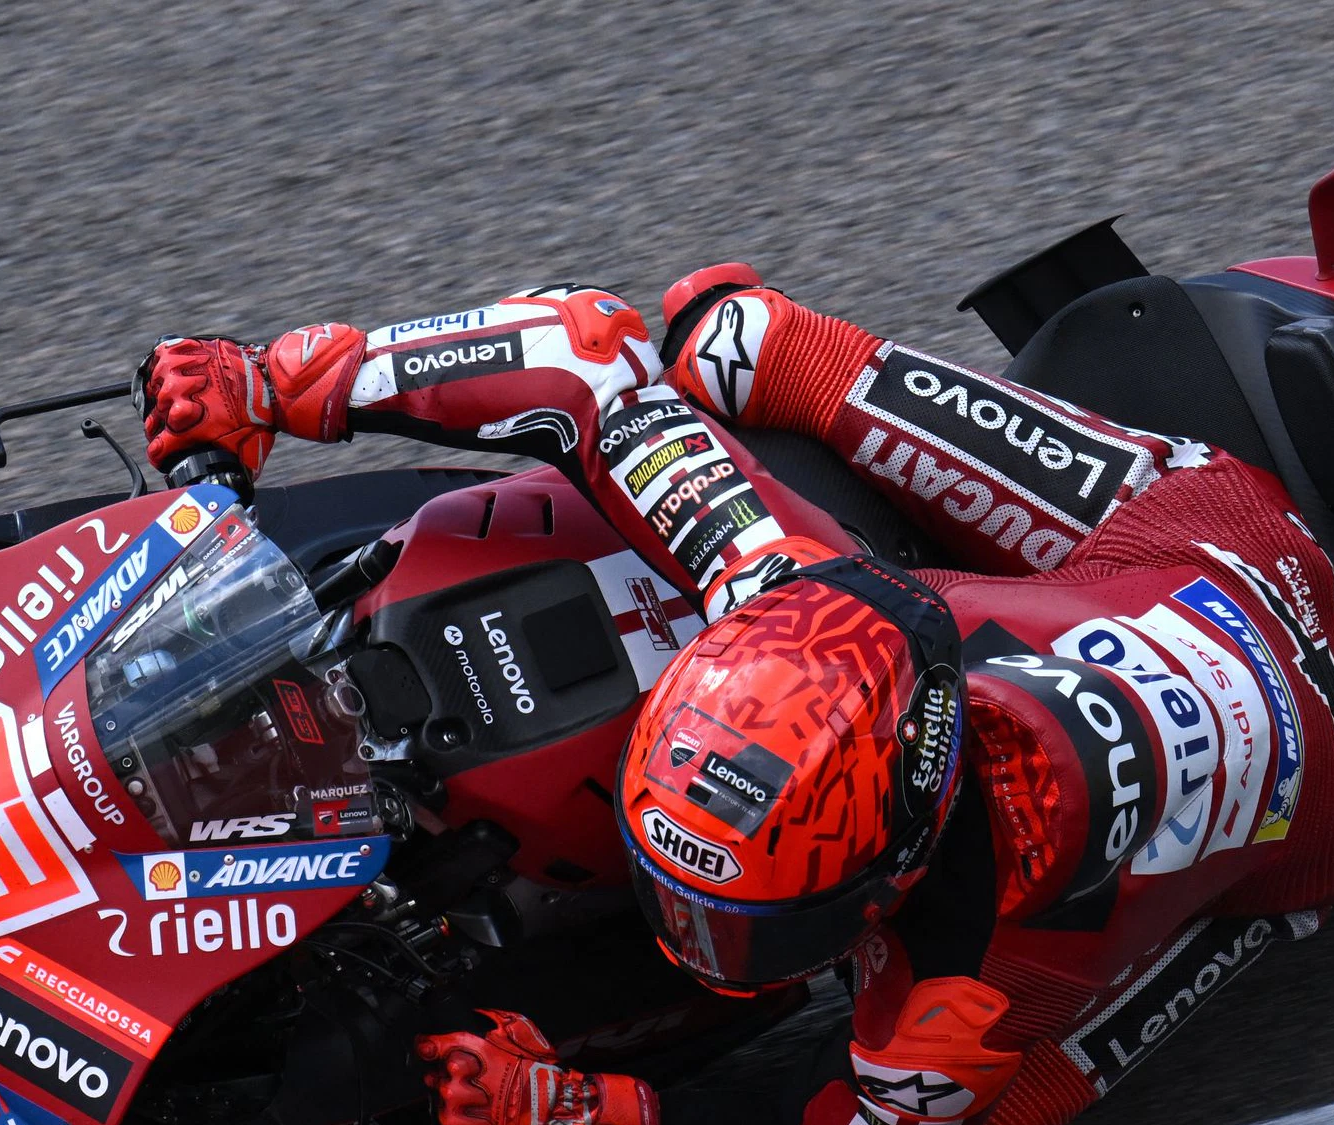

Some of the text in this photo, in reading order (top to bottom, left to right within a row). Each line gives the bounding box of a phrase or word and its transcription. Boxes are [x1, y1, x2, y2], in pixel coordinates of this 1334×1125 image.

[390, 309, 485, 342] Unipol
[404, 341, 513, 375] Lenovo
[903, 369, 1107, 499] Lenovo
[651, 462, 735, 538] aruba.it
[852, 426, 1077, 573] DUCATI
[689, 520, 734, 571] MONSTER
[43, 539, 150, 672] ADVANCE
[111, 565, 189, 653] WRS
[456, 650, 494, 725] motorola
[479, 611, 535, 714] Lenovo
[1202, 600, 1297, 762] MICHELIN
[676, 731, 701, 747] DUCATI
[911, 686, 944, 793] Estrella
[929, 698, 957, 793] Galicia
[1078, 629, 1210, 796] rielo
[1229, 700, 1255, 789] Audi
[53, 700, 125, 825] VARGROUP
[310, 784, 368, 800] MARQUEZ
[706, 757, 766, 802] Lenovo
[985, 653, 1141, 862] enovo
[189, 812, 297, 842] WRS
[339, 810, 368, 819] Lenovo
[650, 817, 726, 878] SHOEI
[203, 850, 363, 889] ADVANCE
[640, 857, 674, 890] Estrella
[675, 885, 715, 910] Galicia
[149, 898, 297, 956] riello
[24, 962, 152, 1044] FRECCIAROSSA
[1108, 918, 1272, 1069] Lenovo
